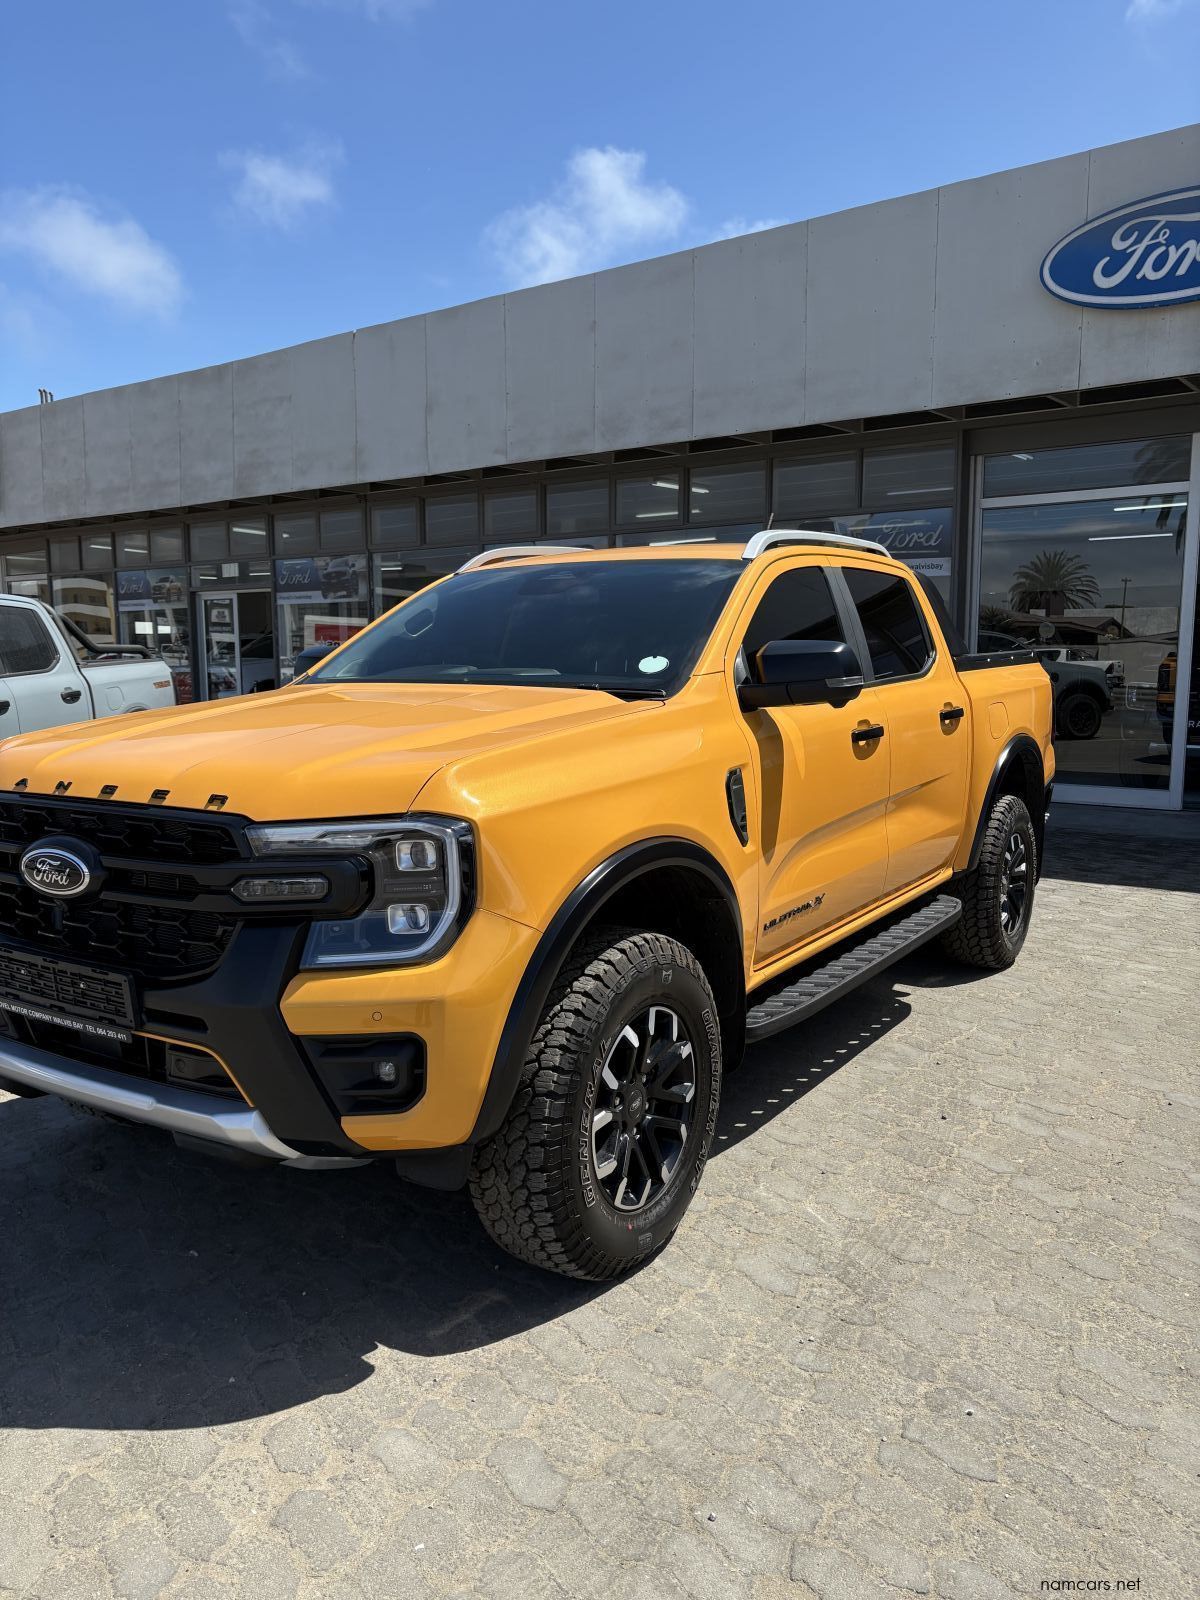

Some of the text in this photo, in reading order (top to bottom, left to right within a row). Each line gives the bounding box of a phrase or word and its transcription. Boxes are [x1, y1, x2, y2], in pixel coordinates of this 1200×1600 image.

[876, 519, 943, 548] Ford
[280, 566, 311, 585] Ford
[33, 857, 70, 886] Ford
[10, 1004, 28, 1015] MOTOR
[28, 1010, 52, 1021] COMPANY
[52, 1016, 73, 1027] WALVIS
[73, 1021, 84, 1030] BAY
[86, 1024, 96, 1033] TEL
[107, 1030, 117, 1039] 203
[117, 1032, 127, 1041] 411
[579, 1037, 612, 1208] GENERAL
